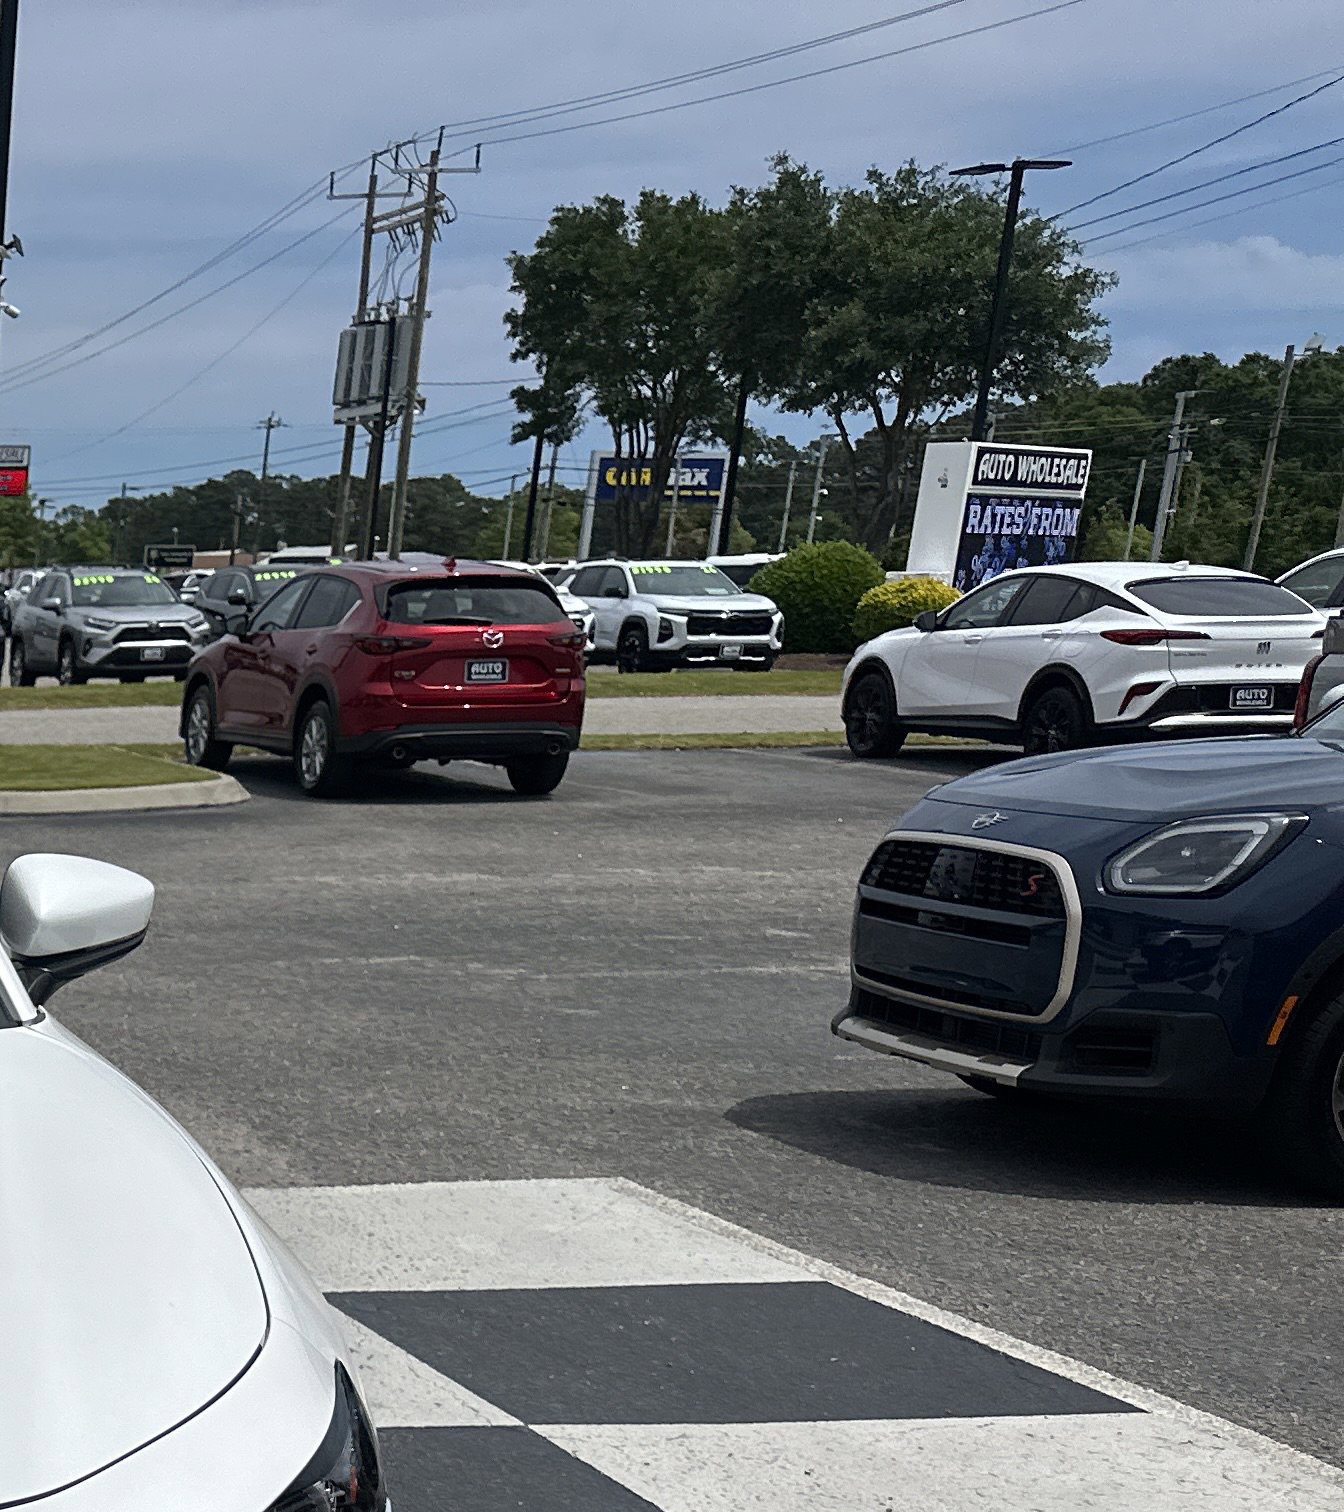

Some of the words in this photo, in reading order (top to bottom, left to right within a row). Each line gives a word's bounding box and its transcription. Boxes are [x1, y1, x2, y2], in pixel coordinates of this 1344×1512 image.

[978, 453, 1015, 482] AUTO
[1017, 455, 1087, 486] WHOLESALE
[965, 504, 1026, 536] RATES
[1027, 507, 1082, 538] FROM
[471, 662, 503, 674] AUTO
[1235, 688, 1268, 700] AUTO
